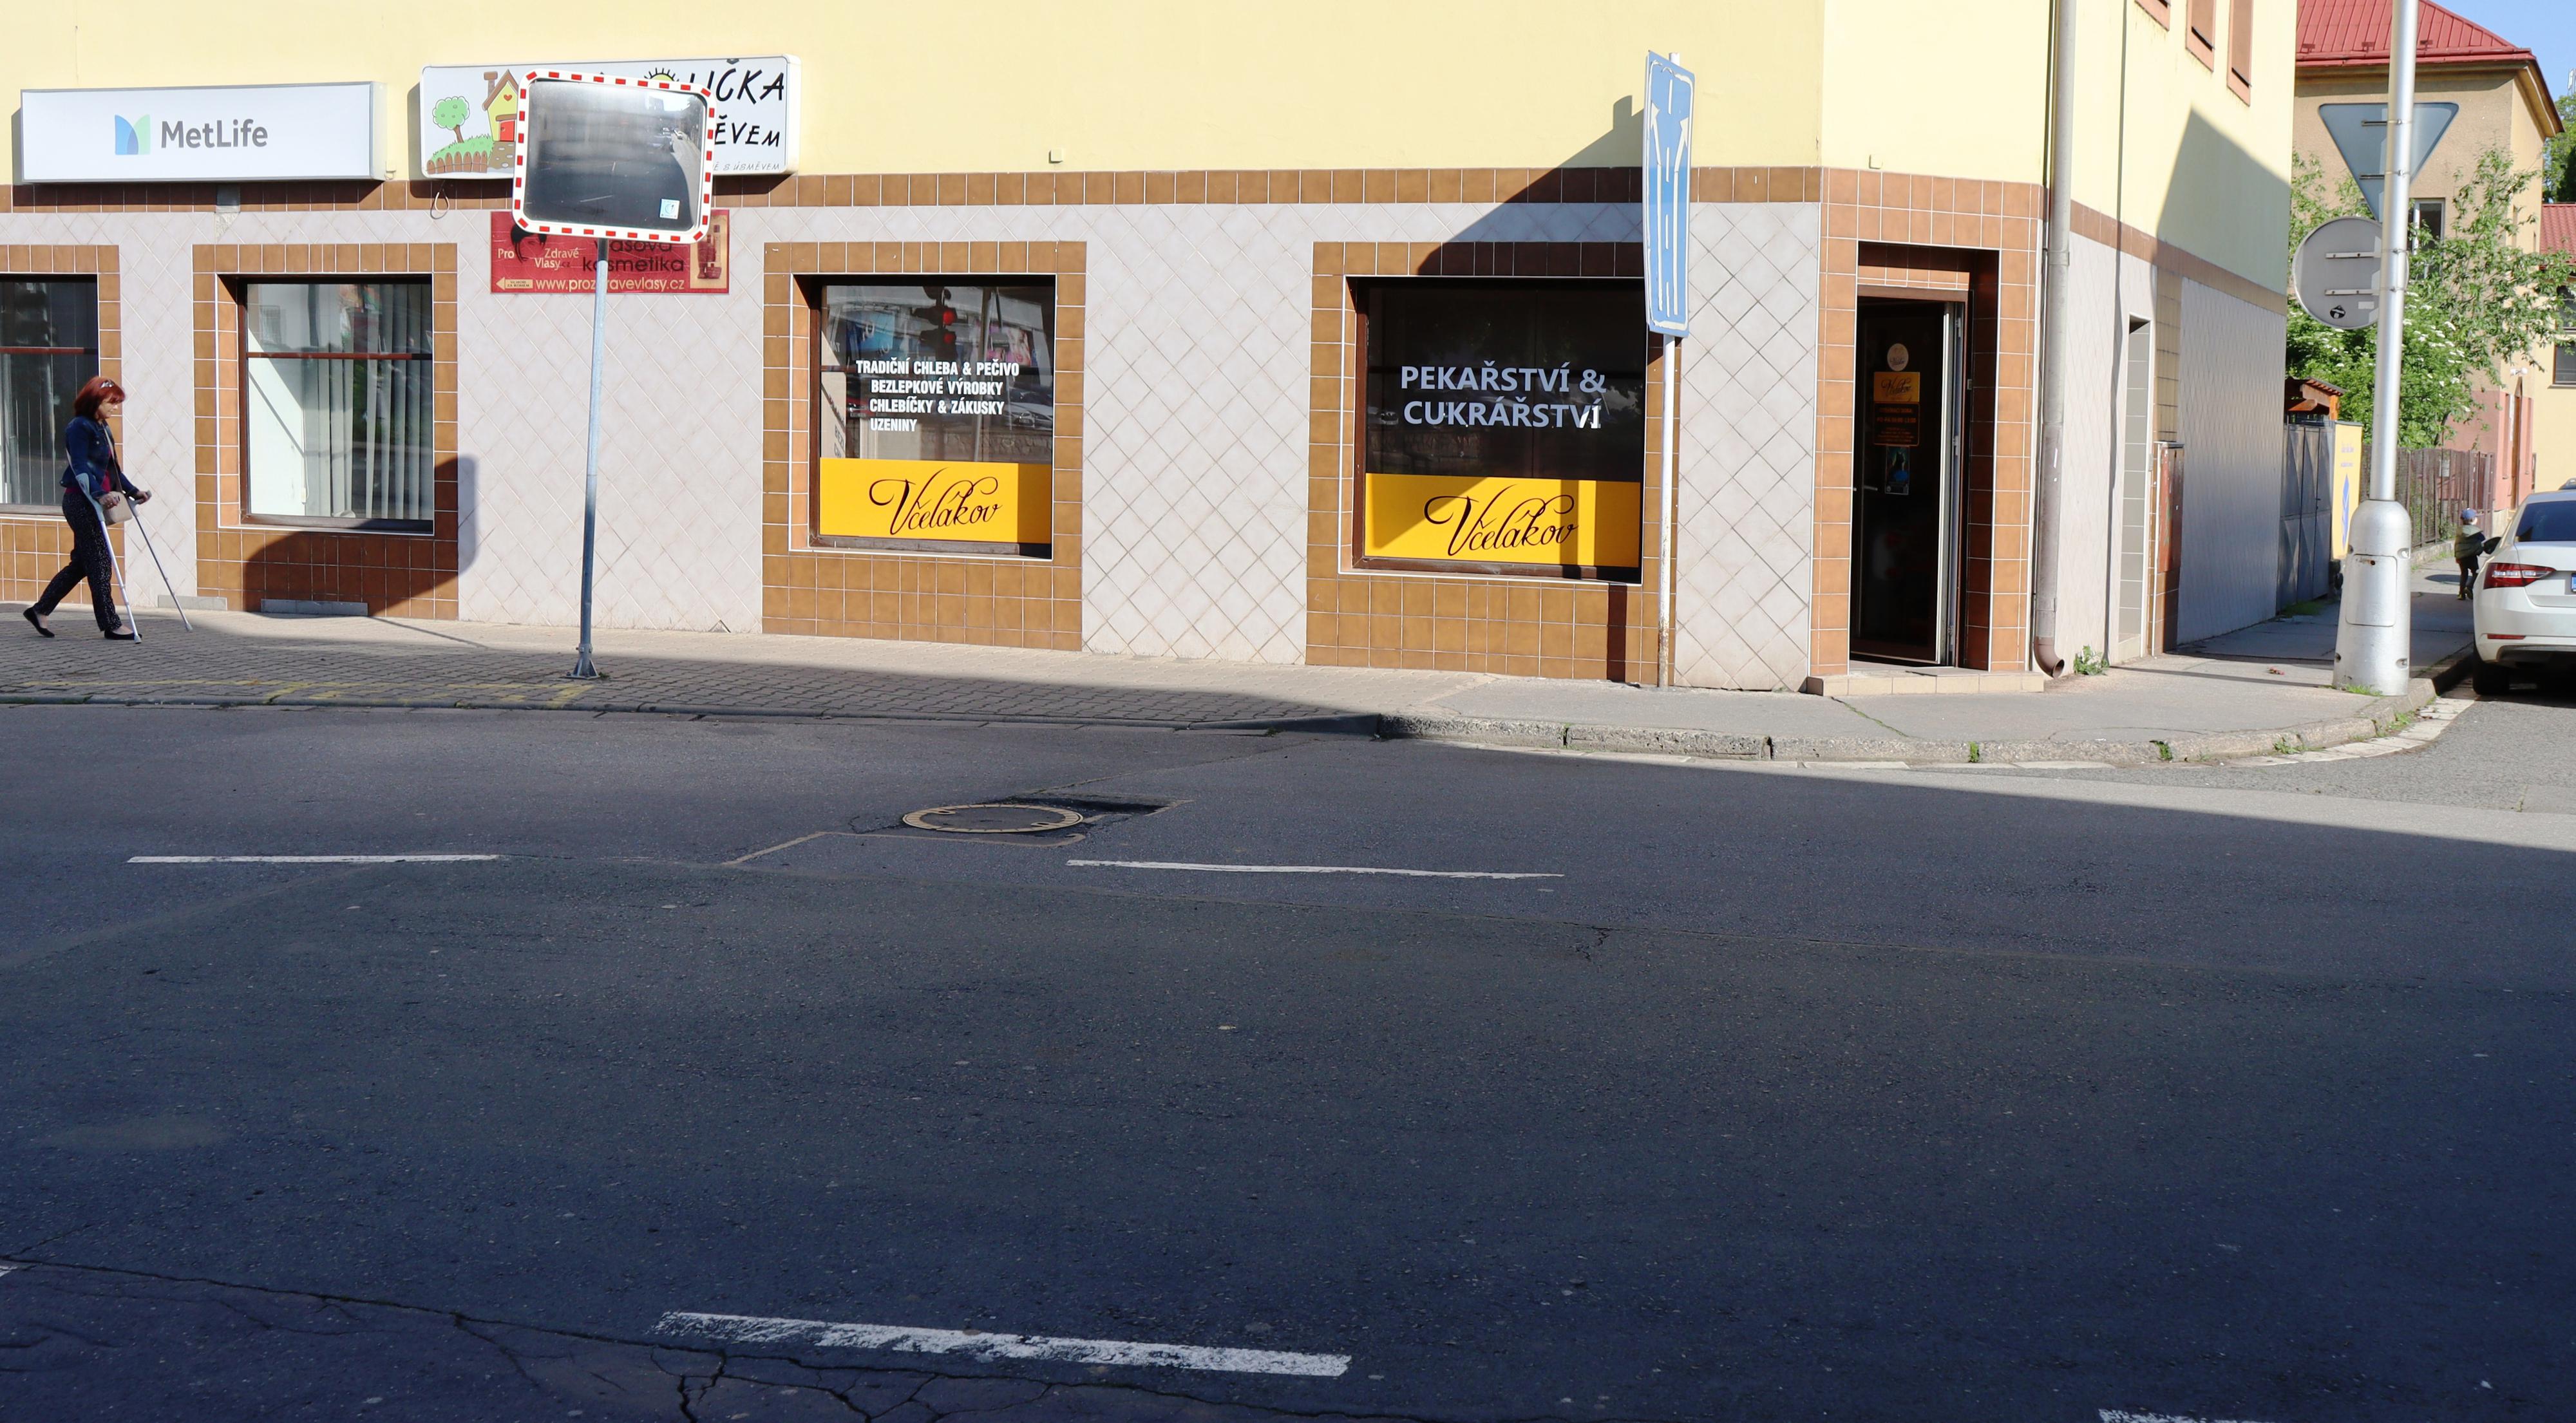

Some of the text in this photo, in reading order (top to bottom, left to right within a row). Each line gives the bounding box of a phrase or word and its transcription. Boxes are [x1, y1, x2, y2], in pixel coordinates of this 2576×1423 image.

[162, 119, 268, 147] MetLife
[715, 115, 780, 147] ĚVEM
[733, 161, 780, 171] ÚSMĚVEM
[498, 247, 580, 259] Pro Zdravé
[536, 277, 685, 292] www.prozravevlasy.cz
[856, 357, 1019, 377] TRADIČNÍ CHLEBA & PEČIVO
[1401, 361, 1607, 393] PEKAŘSTVÍ &
[871, 377, 1003, 395] BEZLEPKOVÉ VÝROBKY
[869, 396, 1005, 415] CHLEBÍČKY & ZÁKUSKY
[1404, 396, 1602, 429] CUKRÁŘSTVÍ
[870, 418, 918, 431] UZENINY
[869, 467, 1002, 535] Včelákov
[1424, 484, 1579, 556] Včelákov
